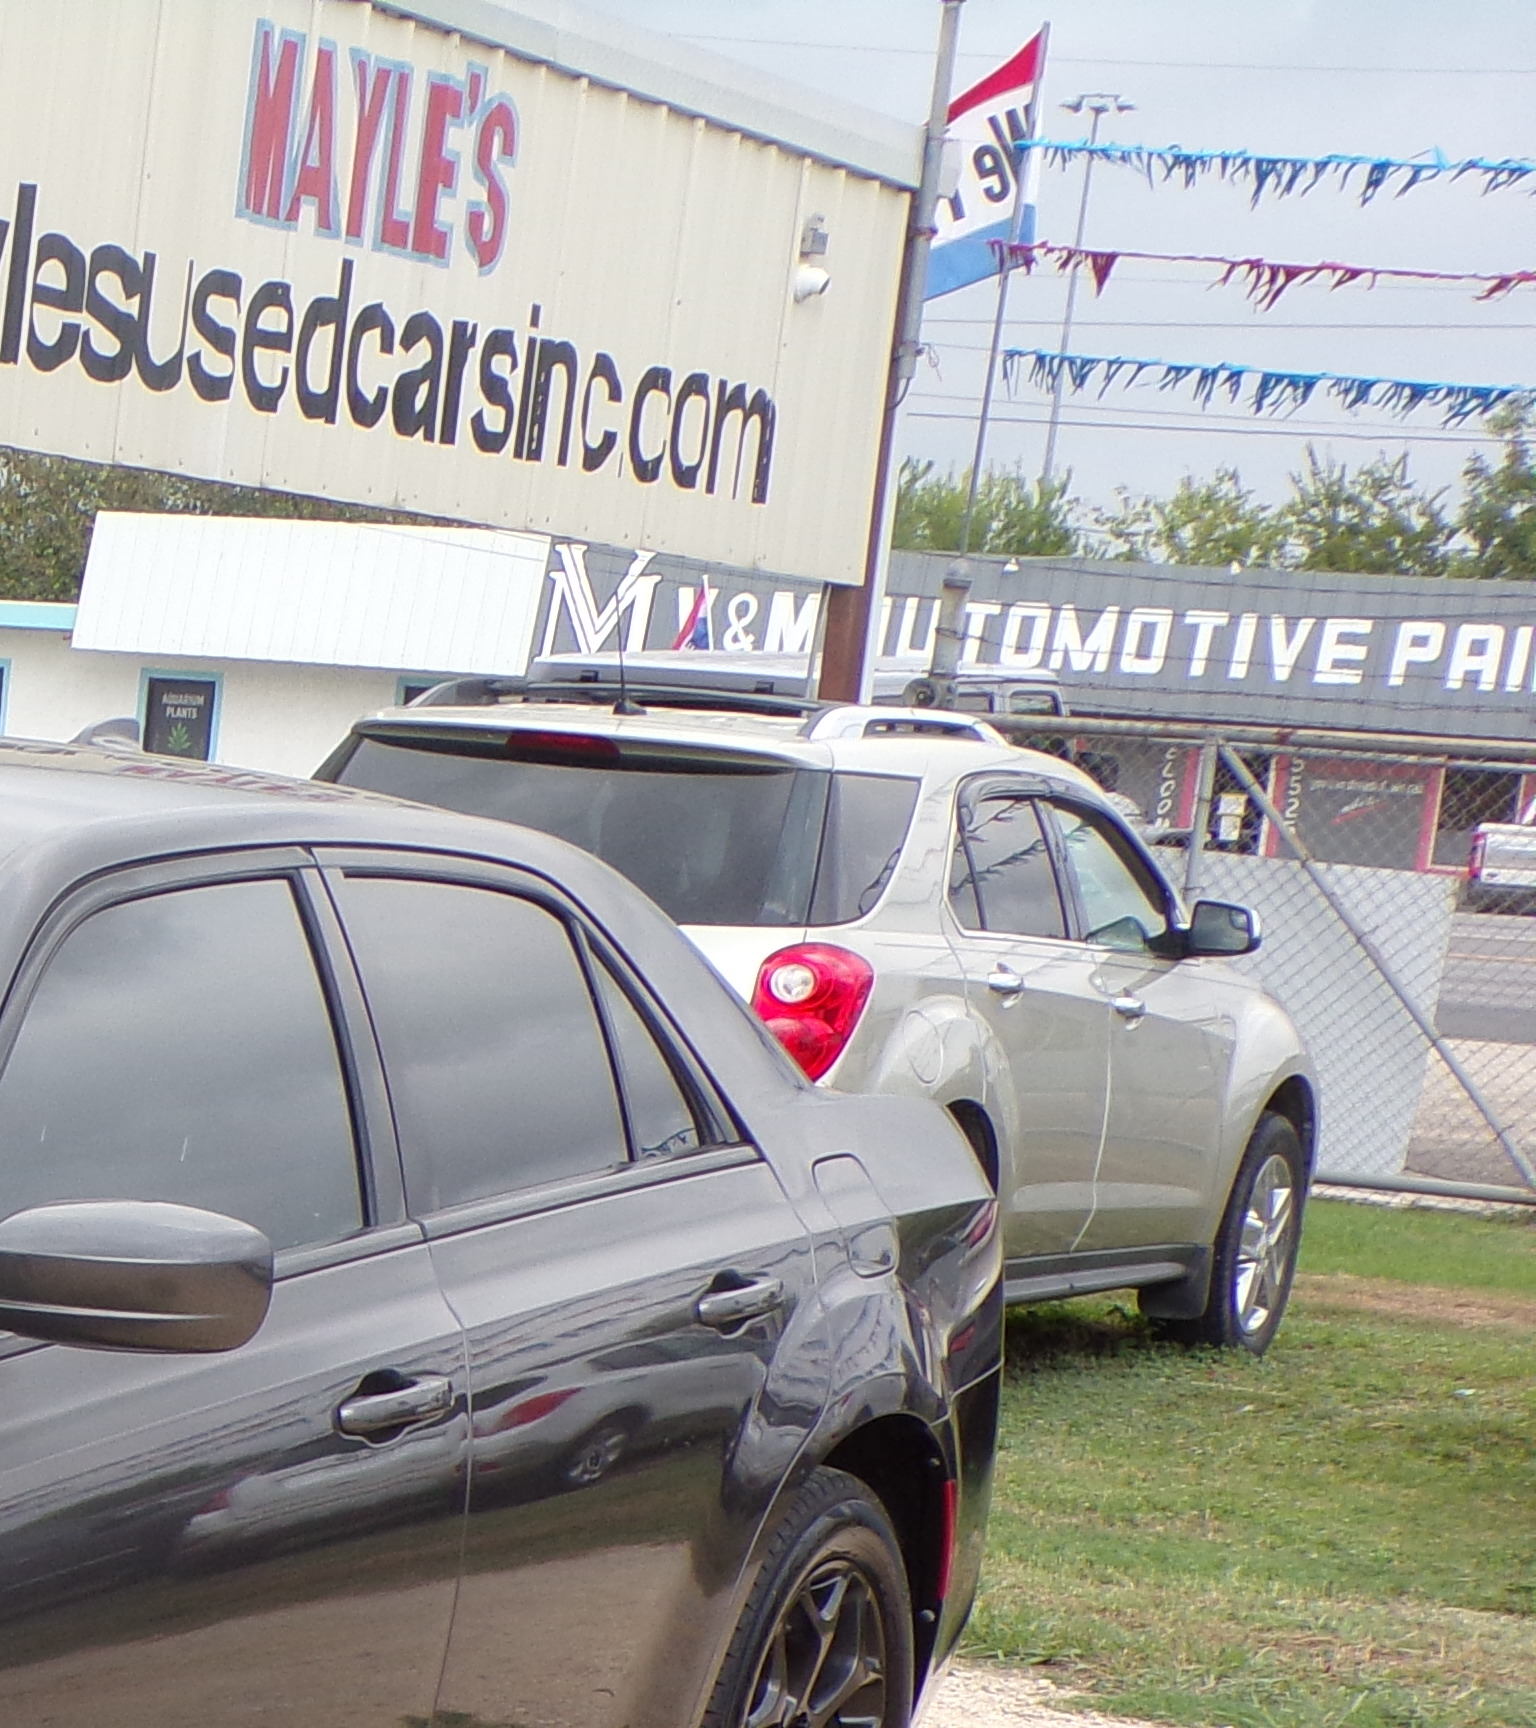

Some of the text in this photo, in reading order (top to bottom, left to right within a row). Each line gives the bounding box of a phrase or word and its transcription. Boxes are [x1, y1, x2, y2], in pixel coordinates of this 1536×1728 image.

[235, 18, 518, 275] MAYLE'S
[1387, 621, 1536, 692] PAI
[161, 692, 205, 706] AQUARIUM
[165, 706, 199, 719] PLANTS
